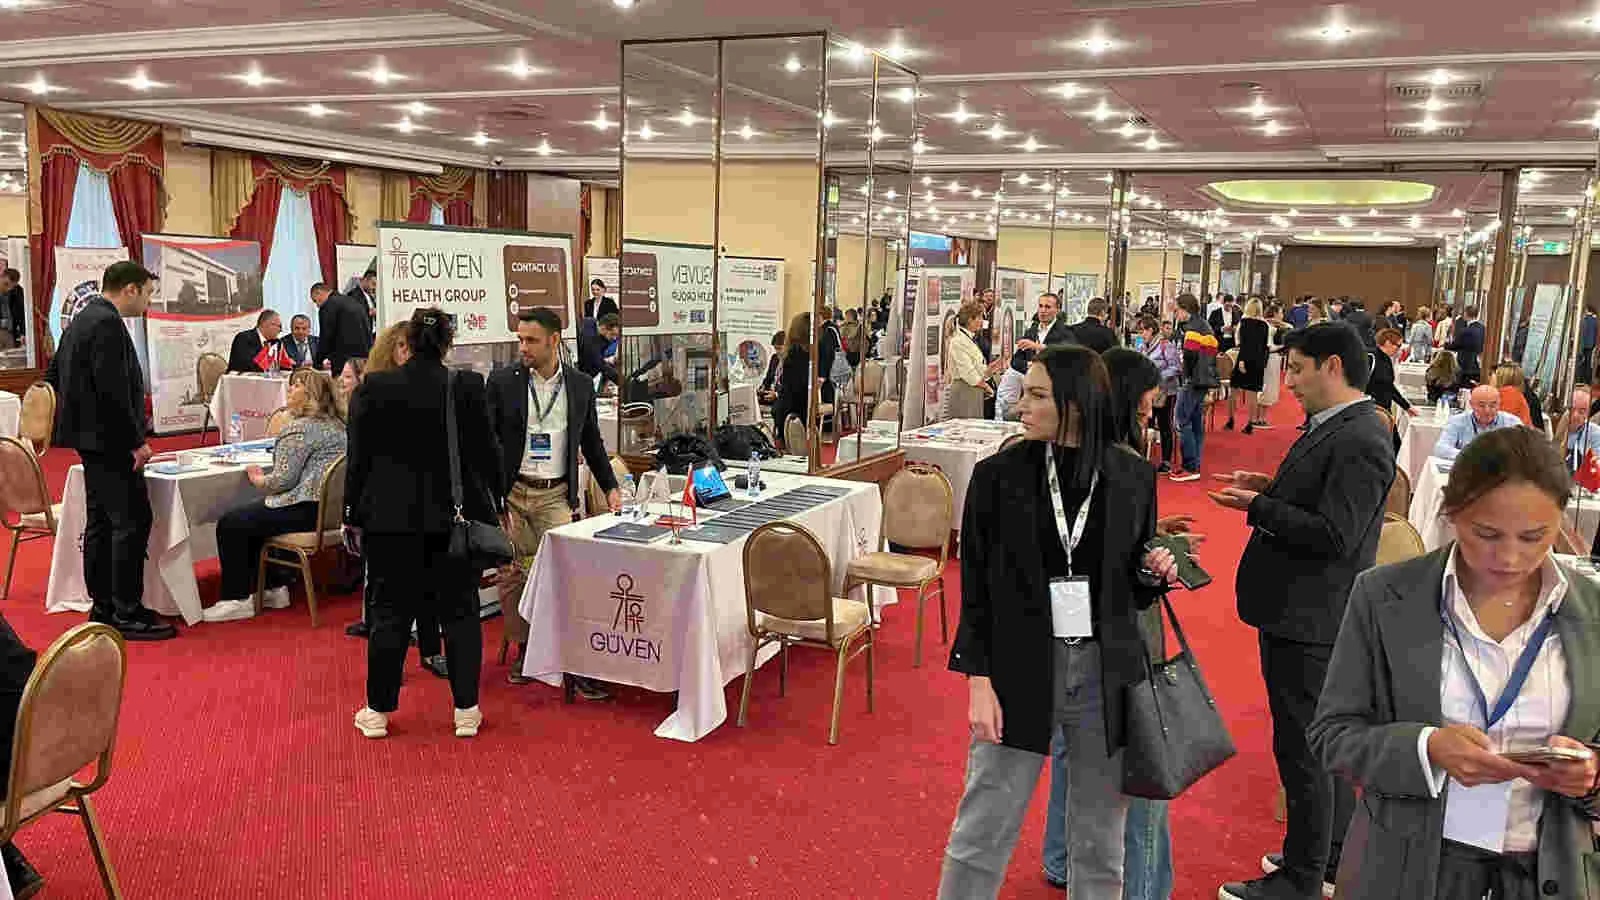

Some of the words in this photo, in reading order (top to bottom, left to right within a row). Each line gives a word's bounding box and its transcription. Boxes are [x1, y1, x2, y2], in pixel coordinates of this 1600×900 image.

[410, 252, 484, 279] GÜVEN
[511, 262, 546, 273] CONTACT
[392, 288, 442, 302] HEALTH
[445, 288, 487, 302] GROUP
[590, 632, 661, 663] GÜVEN
